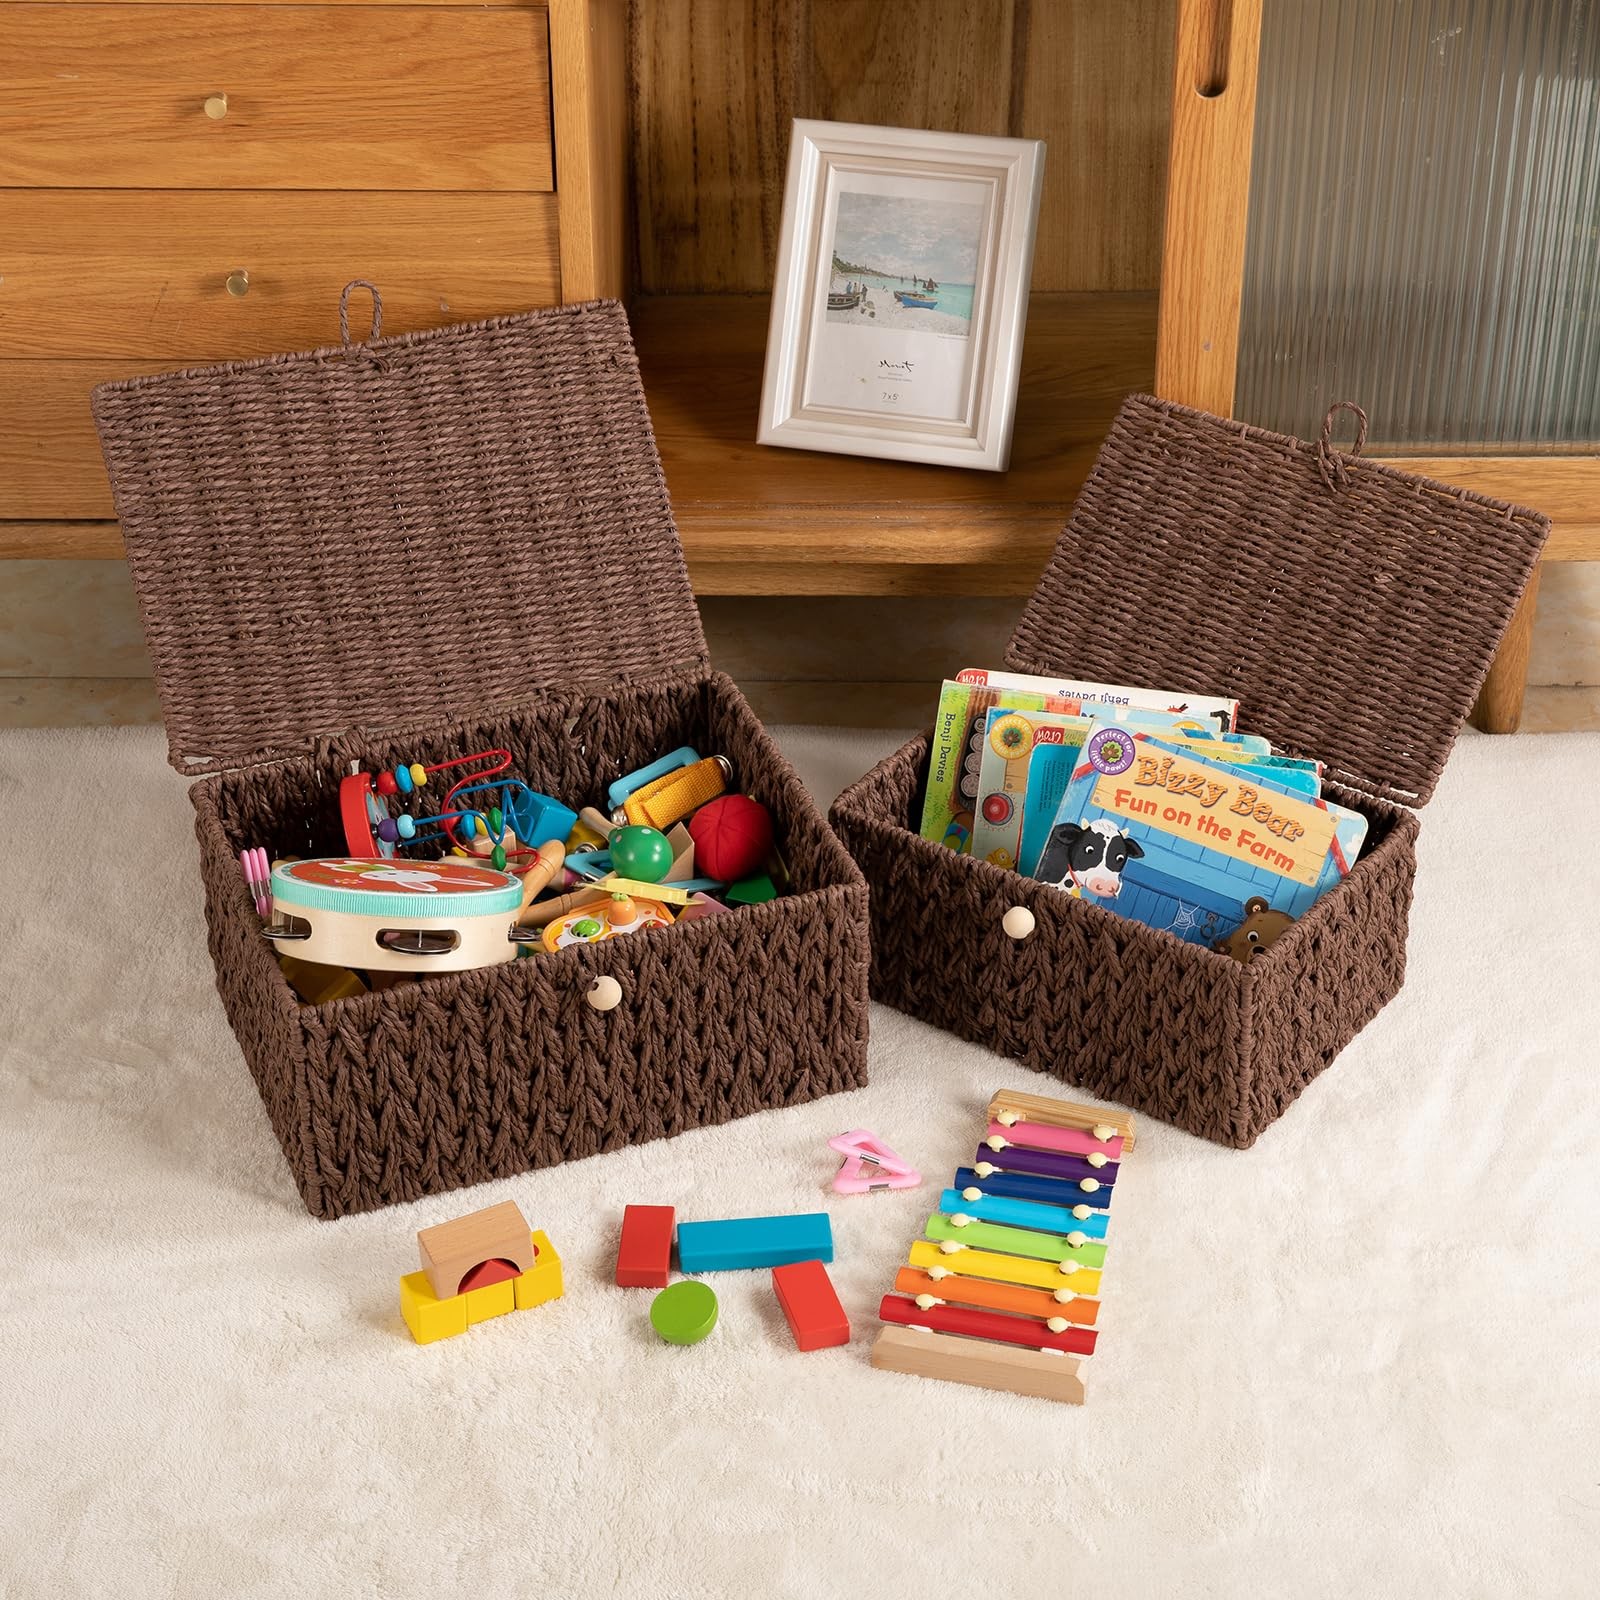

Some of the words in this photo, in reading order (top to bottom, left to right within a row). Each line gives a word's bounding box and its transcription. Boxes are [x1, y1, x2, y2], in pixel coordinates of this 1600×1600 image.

[1059, 689, 1096, 701] Davies
[941, 713, 956, 742] Benji
[1095, 731, 1125, 743] Perfect
[1124, 741, 1132, 753] for
[936, 746, 951, 783] Davies
[1091, 750, 1104, 768] little
[1104, 760, 1127, 773] paws!
[1135, 755, 1228, 808] Bizzy
[1230, 784, 1305, 842] Bear
[1114, 788, 1158, 816] Fun
[1162, 806, 1192, 827] on
[1198, 814, 1233, 841] the
[1237, 829, 1295, 873] Farm
